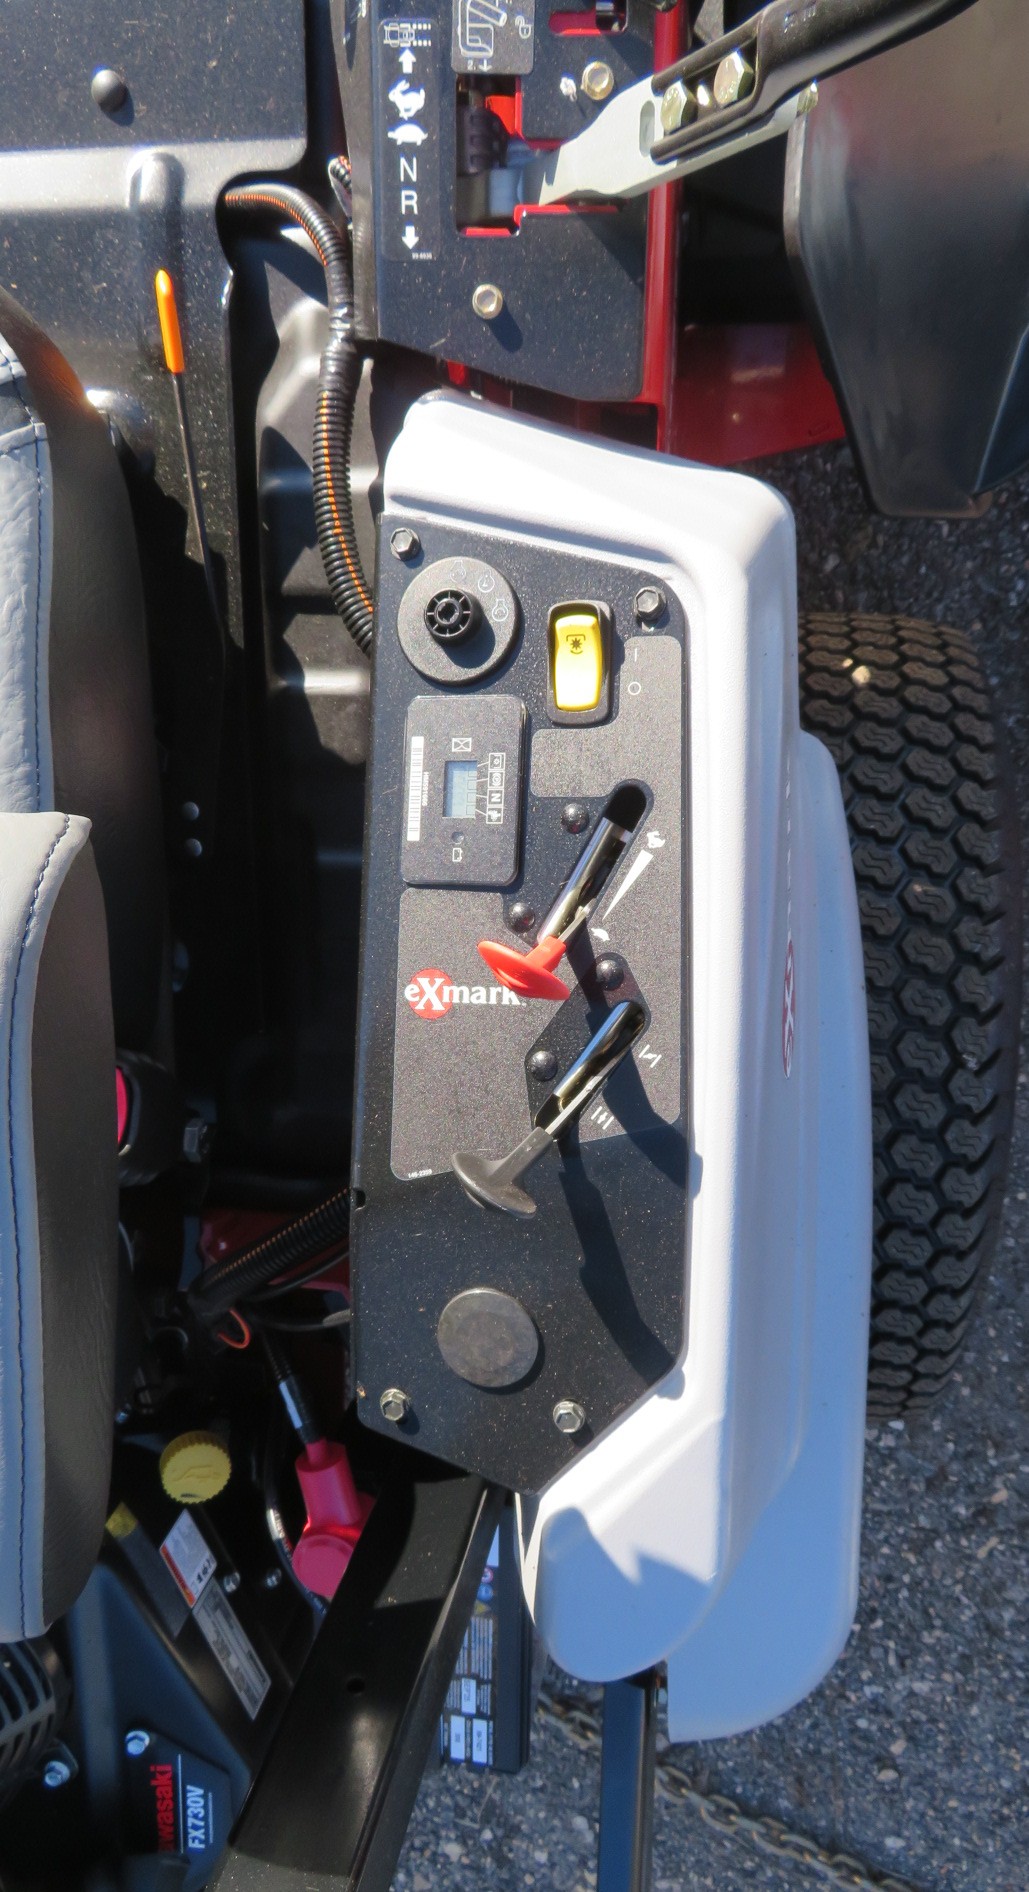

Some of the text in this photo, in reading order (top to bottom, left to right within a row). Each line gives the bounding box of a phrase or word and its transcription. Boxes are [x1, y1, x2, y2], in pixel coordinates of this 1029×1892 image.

[400, 157, 417, 182] N
[401, 190, 418, 215] R
[150, 1764, 174, 1852] awasaki
[186, 1785, 205, 1849] FX730V
